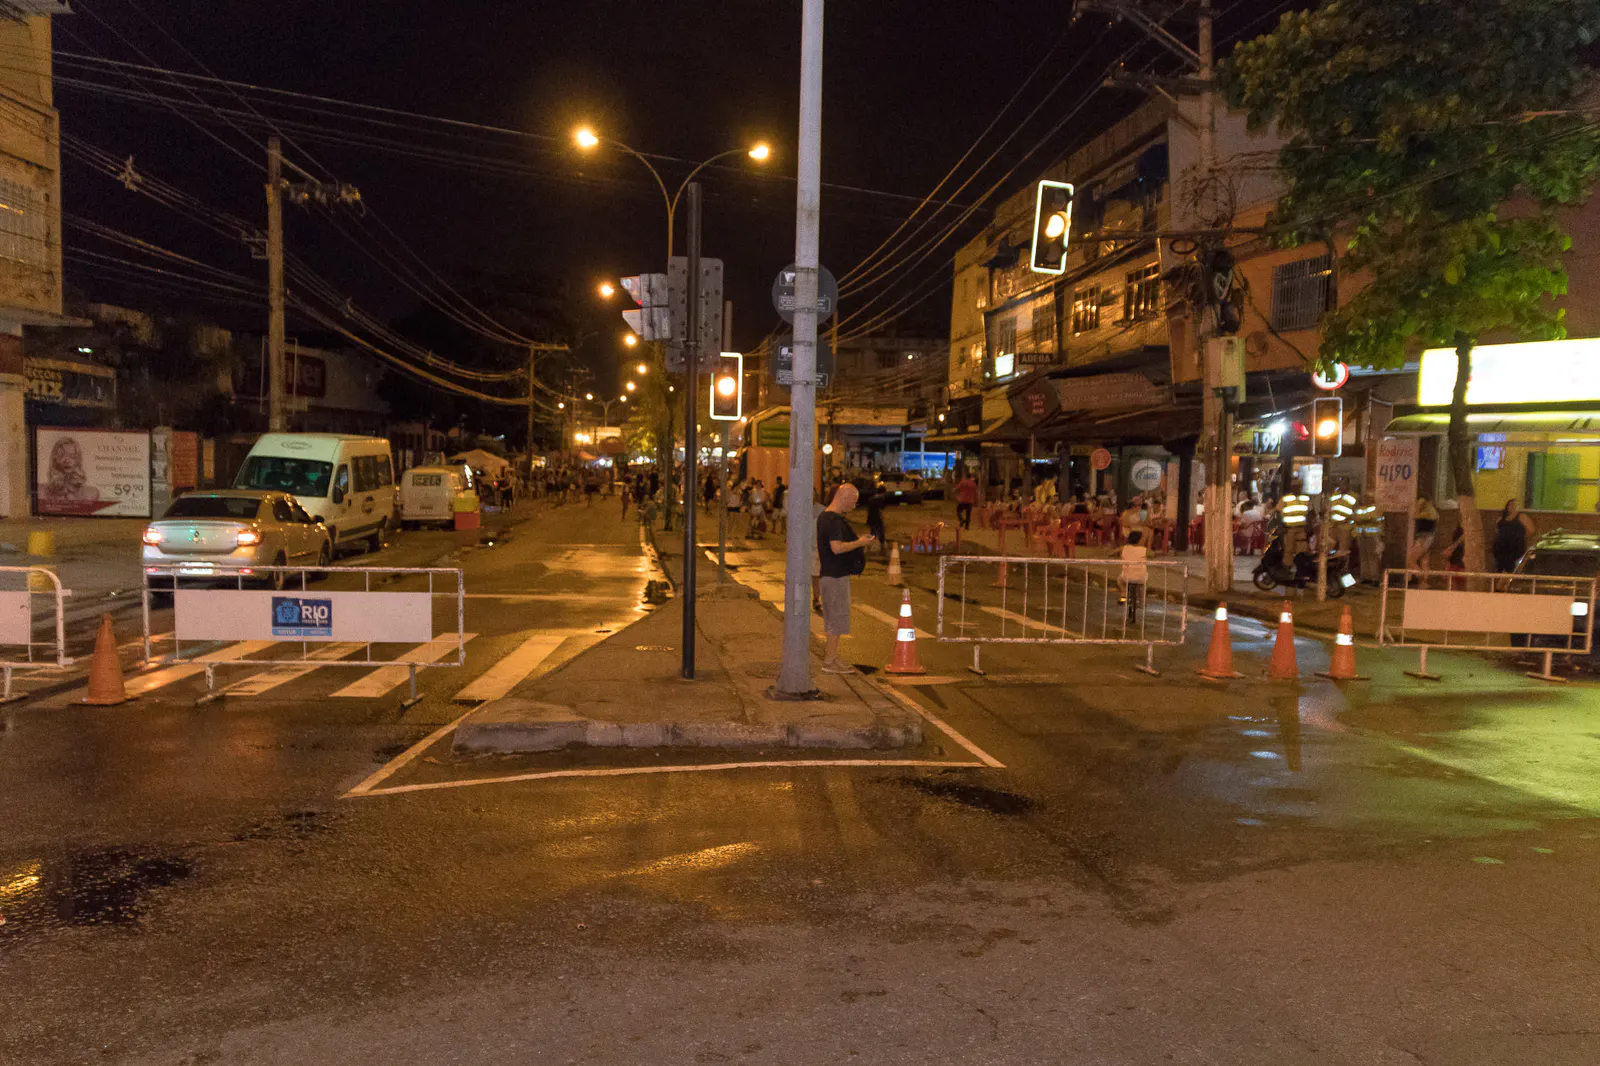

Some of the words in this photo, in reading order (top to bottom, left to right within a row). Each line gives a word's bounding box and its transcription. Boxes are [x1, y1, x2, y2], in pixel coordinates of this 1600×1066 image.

[23, 379, 63, 396] MIX
[1253, 431, 1279, 455] 1,99
[302, 605, 329, 619] RIO
